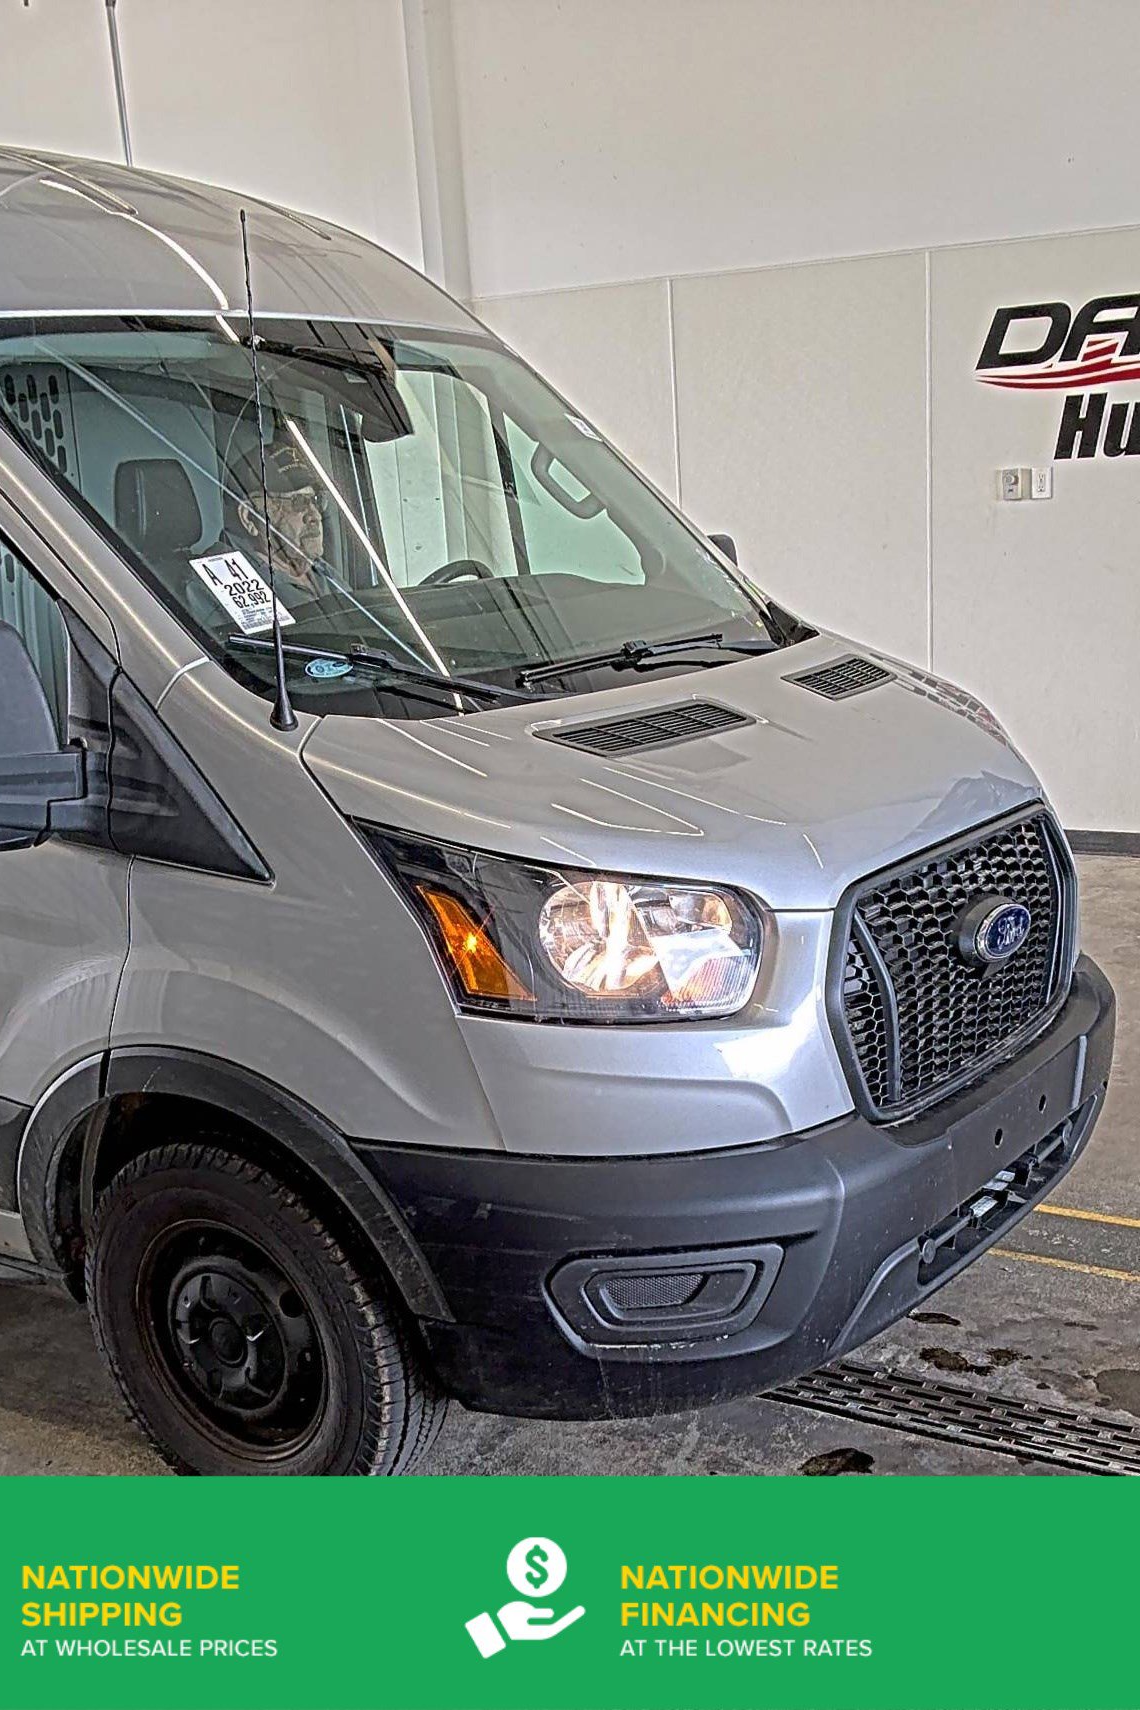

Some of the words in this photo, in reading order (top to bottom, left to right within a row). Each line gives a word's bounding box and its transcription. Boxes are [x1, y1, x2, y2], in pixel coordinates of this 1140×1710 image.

[202, 564, 223, 586] A
[224, 558, 249, 581] 41
[224, 578, 264, 597] 2022
[232, 591, 271, 609] 62,992
